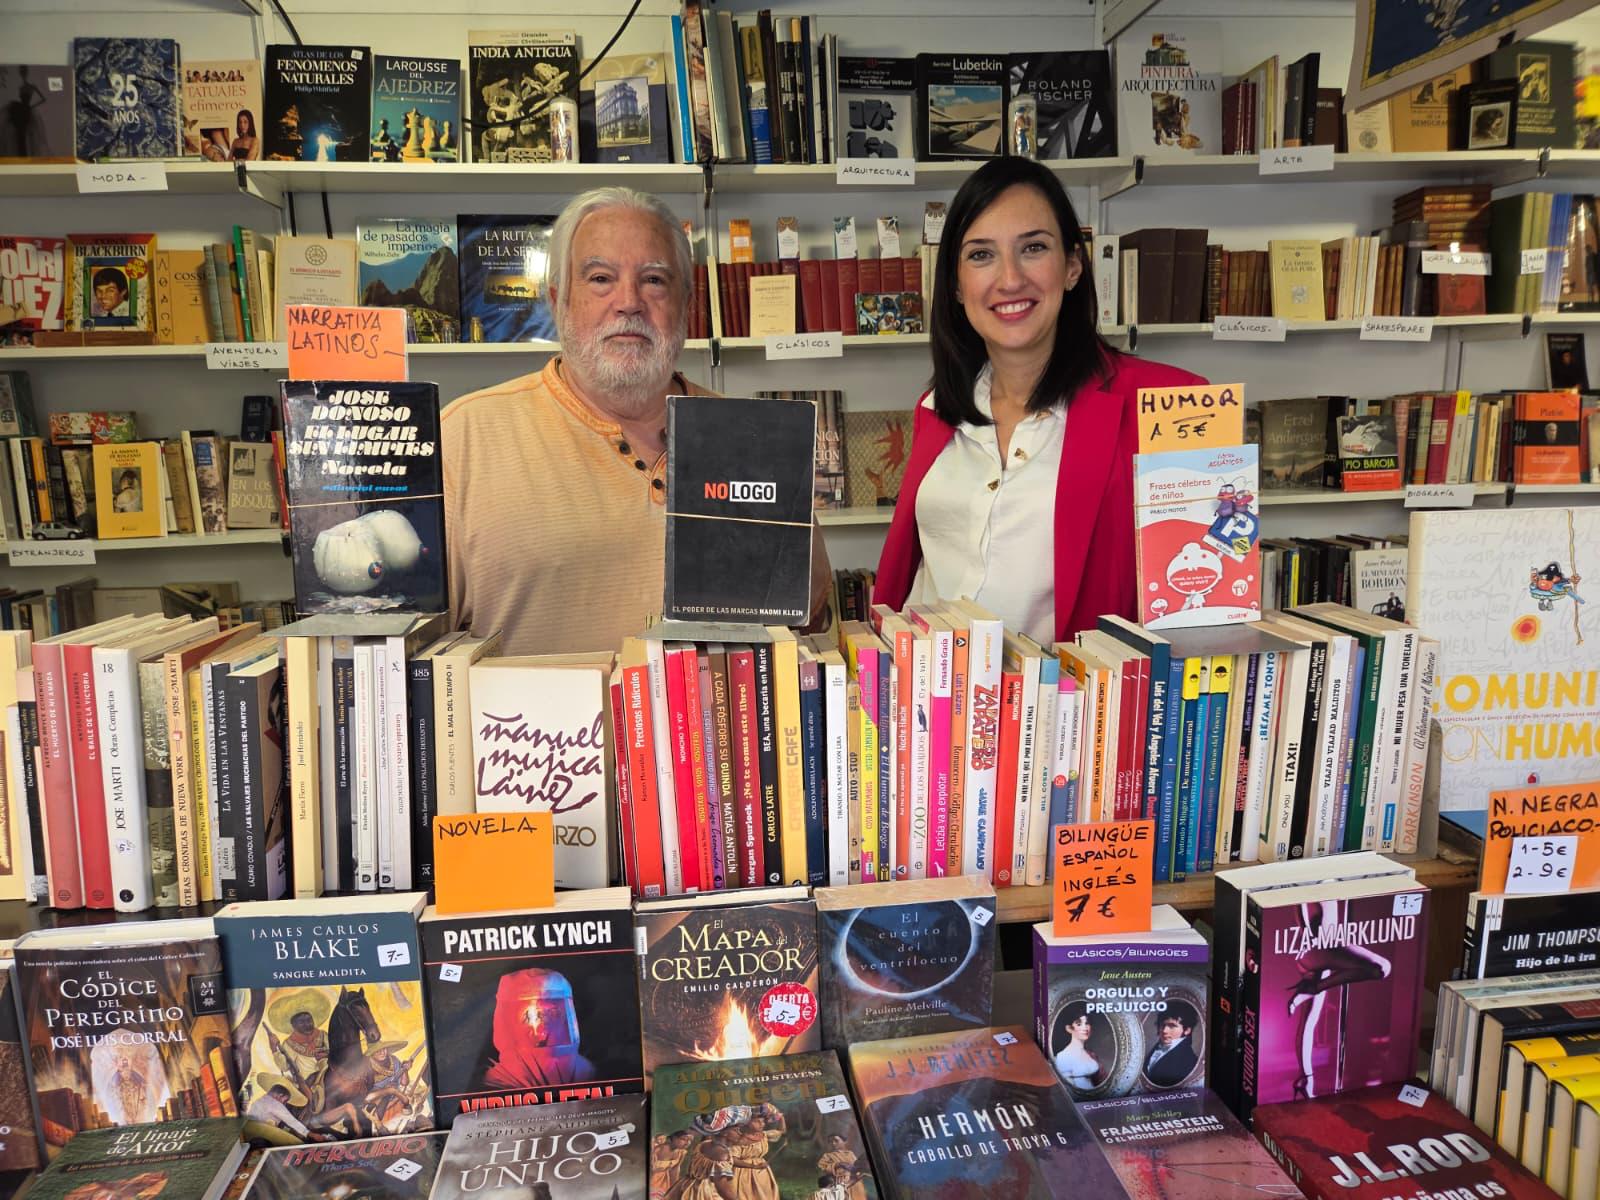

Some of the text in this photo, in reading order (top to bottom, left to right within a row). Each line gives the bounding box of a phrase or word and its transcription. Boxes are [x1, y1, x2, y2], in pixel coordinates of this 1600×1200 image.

[473, 46, 571, 58] INDIA ANTIGUA
[277, 59, 357, 71] FENÓMENOS
[386, 59, 447, 73] LAROUSSE
[953, 57, 1002, 71] Lubetkin
[1141, 65, 1194, 79] PINTURA
[280, 73, 354, 84] NATURALES
[377, 78, 456, 96] AJEDREZ
[1029, 79, 1092, 90] ROLAND
[1121, 78, 1216, 93] ARQUITECTURA
[110, 74, 138, 108] 25
[186, 86, 247, 97] TATUAJES
[113, 108, 140, 125] AÑOS
[1274, 156, 1304, 165] ARTE
[842, 166, 910, 178] ARQUITECTURA
[395, 221, 450, 235] La magia
[484, 230, 535, 242] LA RUTA
[363, 230, 428, 244] de pasados
[388, 240, 438, 251] imperios
[75, 245, 146, 257] BLACKBURN
[478, 246, 512, 257] DE LA
[288, 308, 382, 331] NARRATIVA
[1365, 322, 1425, 335] SHAKESPEARE
[212, 346, 279, 356] AVENTURAS
[292, 332, 378, 359] LATINOS
[776, 339, 831, 349] CLÁSICOS
[219, 359, 260, 369] VIAJES
[328, 389, 390, 406] JOSE
[1141, 388, 1238, 414] HUMOR
[311, 405, 411, 422] DONOSO
[303, 426, 418, 441] EL LUGAR
[1150, 421, 1208, 440] A 5€
[289, 440, 435, 457] SIN LIMITES
[320, 459, 407, 476] Novela
[232, 479, 272, 491] EN LOS
[704, 483, 775, 500] NO LOGO
[1150, 478, 1212, 491] Frases célebres
[1150, 490, 1184, 500] de niños
[103, 664, 115, 673] 18
[413, 668, 430, 680] 485
[940, 660, 948, 689] Fernando
[629, 672, 645, 748] Preciosos Ridículos
[480, 710, 604, 749] manuel
[758, 648, 776, 842] CARLOS LATRE BEA, una becaria en Marte
[488, 745, 602, 786] mujica
[1285, 742, 1298, 782] ¡TAXI!
[936, 772, 947, 806] explotar
[1403, 762, 1423, 846] PARKINSON
[1493, 792, 1598, 817] N. NEGRA
[937, 813, 946, 824] va
[438, 816, 537, 840] NOVELA
[1058, 826, 1149, 845] BILINGÜE
[935, 825, 946, 851] Letizia
[1063, 843, 1139, 867] ESPAÑOL
[1063, 866, 1137, 893] INGLÉS
[1097, 895, 1118, 918] €
[714, 919, 724, 929] El
[902, 911, 920, 924] El
[252, 923, 380, 940] JAMES CARLOS
[443, 920, 612, 954] PATRICK LYNCH
[678, 924, 788, 953] MAPA del
[878, 926, 941, 940] cuento
[1274, 915, 1416, 961] LIZA MARKLUND
[275, 938, 361, 960] BLAKE
[897, 942, 921, 954] del
[1502, 934, 1530, 952] JIM
[652, 948, 805, 982] CREADOR
[860, 954, 958, 971] ventrílocuo
[1515, 952, 1596, 968] Hijo de la ira
[98, 971, 113, 980] EL
[273, 968, 367, 980] SANGRE MALDITA
[1099, 970, 1152, 981] Jane Austen
[59, 977, 157, 999] CÓDICE
[684, 978, 778, 993] EMILIO CALDERÓN
[1085, 987, 1169, 1000] ORGULLO Y
[98, 999, 123, 1009] DEL
[768, 992, 810, 1006] OFERTA
[1086, 1000, 1168, 1014] PREJUICIO
[45, 1005, 184, 1029] PEREGRINO
[864, 1000, 947, 1017] Pauline Melville
[50, 1030, 187, 1050] JOSÉ LUIS CORRAL
[1242, 1008, 1256, 1099] STUDIO SEX
[734, 1076, 769, 1085] DAVID
[772, 1070, 822, 1080] STEVENS
[918, 1102, 1034, 1139] HERMÓN
[1099, 1114, 1219, 1138] FRANKENSTEIN
[114, 1127, 198, 1145] El linaje
[106, 1139, 192, 1157] de Aitor
[283, 1136, 428, 1167] MERCURIO
[486, 1131, 598, 1166] HIJO
[907, 1132, 1068, 1164] CABALLO DE TROYA 6
[460, 1152, 622, 1192] ÚNICO
